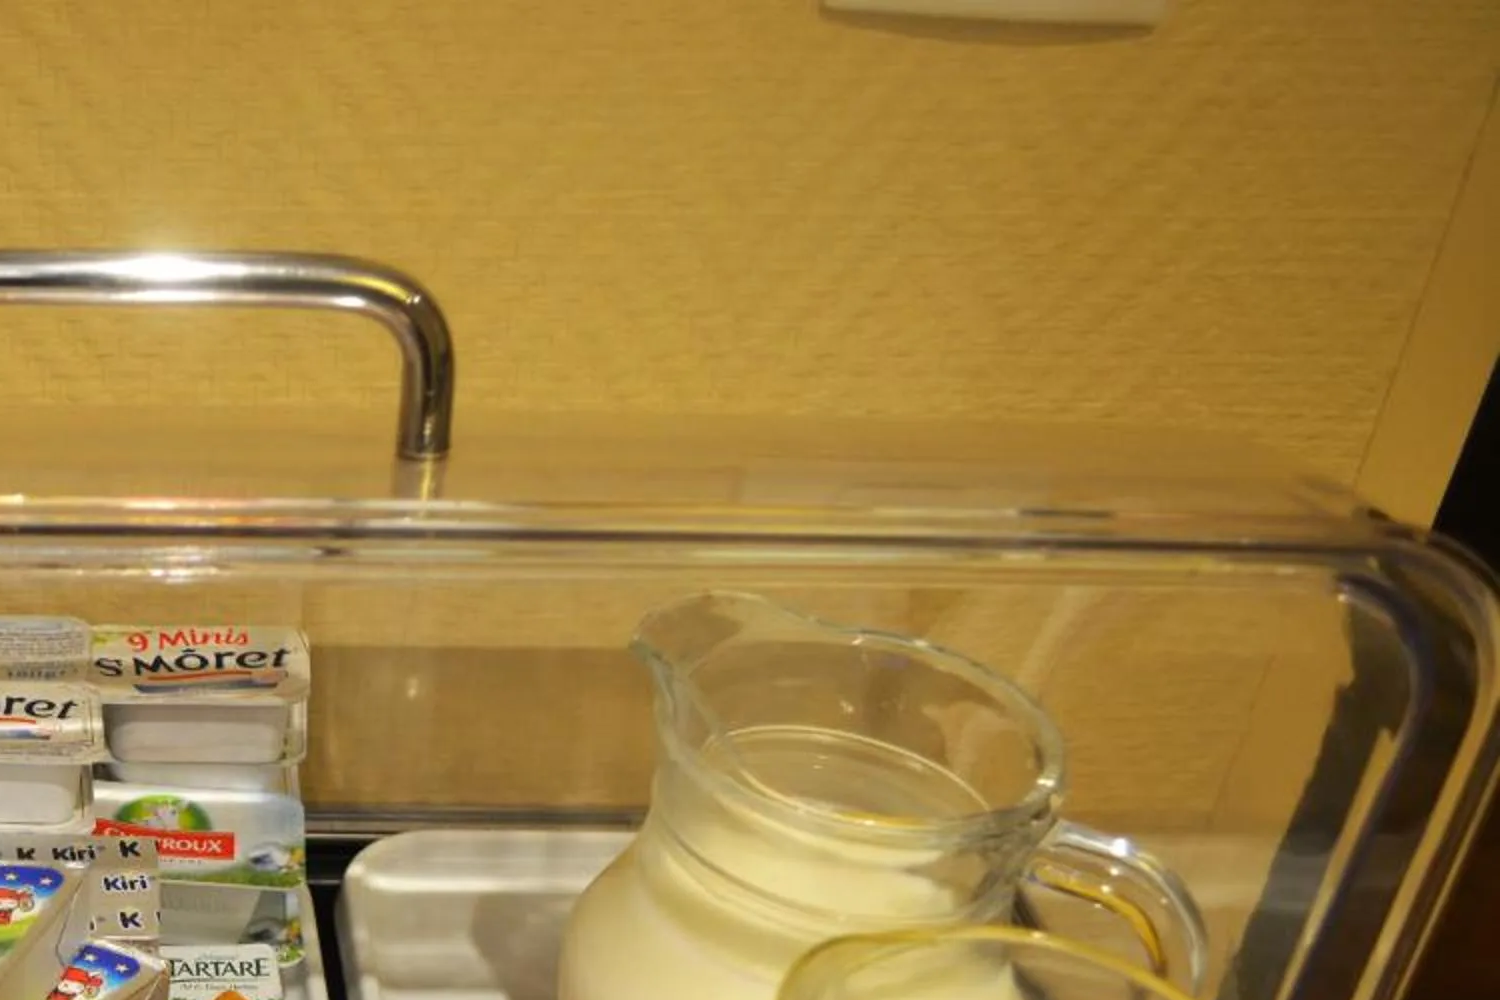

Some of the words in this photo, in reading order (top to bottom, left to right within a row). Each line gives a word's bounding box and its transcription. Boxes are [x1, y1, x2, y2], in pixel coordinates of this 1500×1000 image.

[128, 632, 148, 651] 9
[158, 627, 249, 650] Minis
[52, 845, 96, 861] Kiri
[103, 875, 148, 891] Kiri
